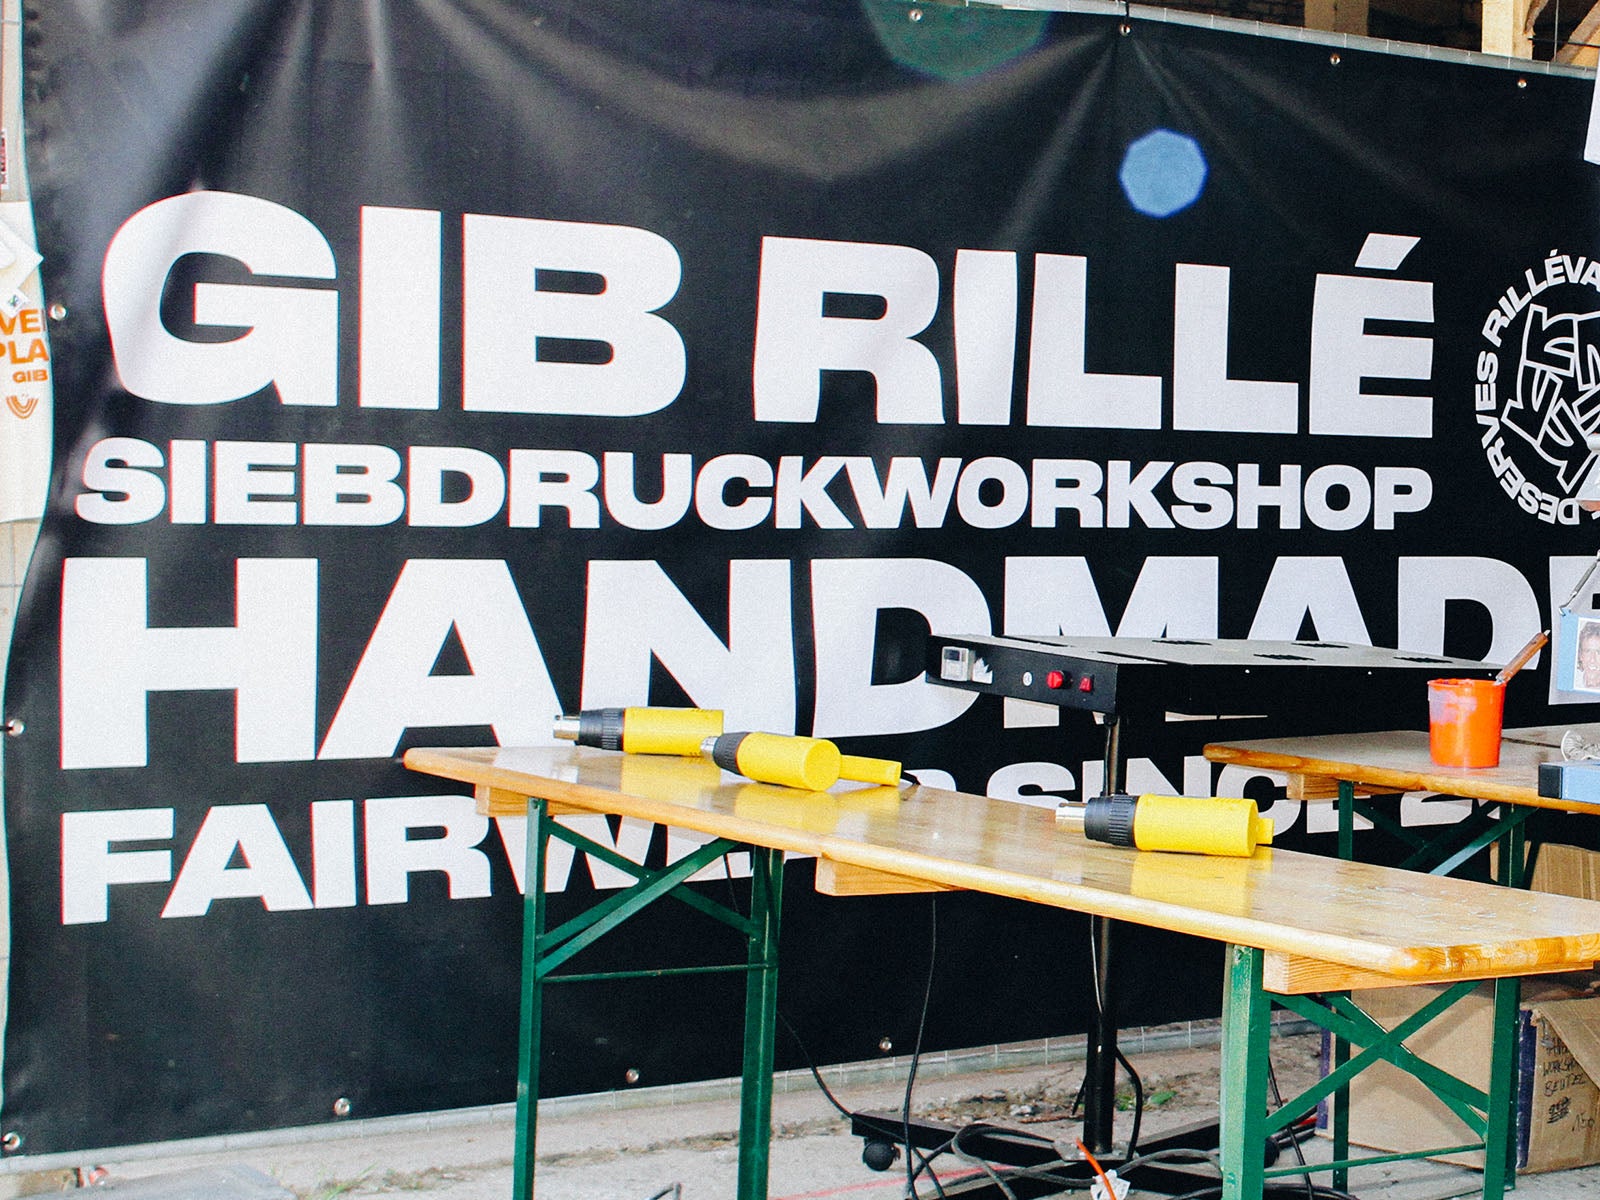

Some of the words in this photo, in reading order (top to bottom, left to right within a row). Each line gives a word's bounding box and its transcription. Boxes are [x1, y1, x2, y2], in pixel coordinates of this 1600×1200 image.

[12, 368, 48, 383] GIB
[103, 190, 688, 417] GIB
[752, 233, 1434, 439] RILLÉ
[75, 437, 1433, 530] SIEBDRUCKWORKSHOP
[1475, 351, 1580, 526] DESERVES
